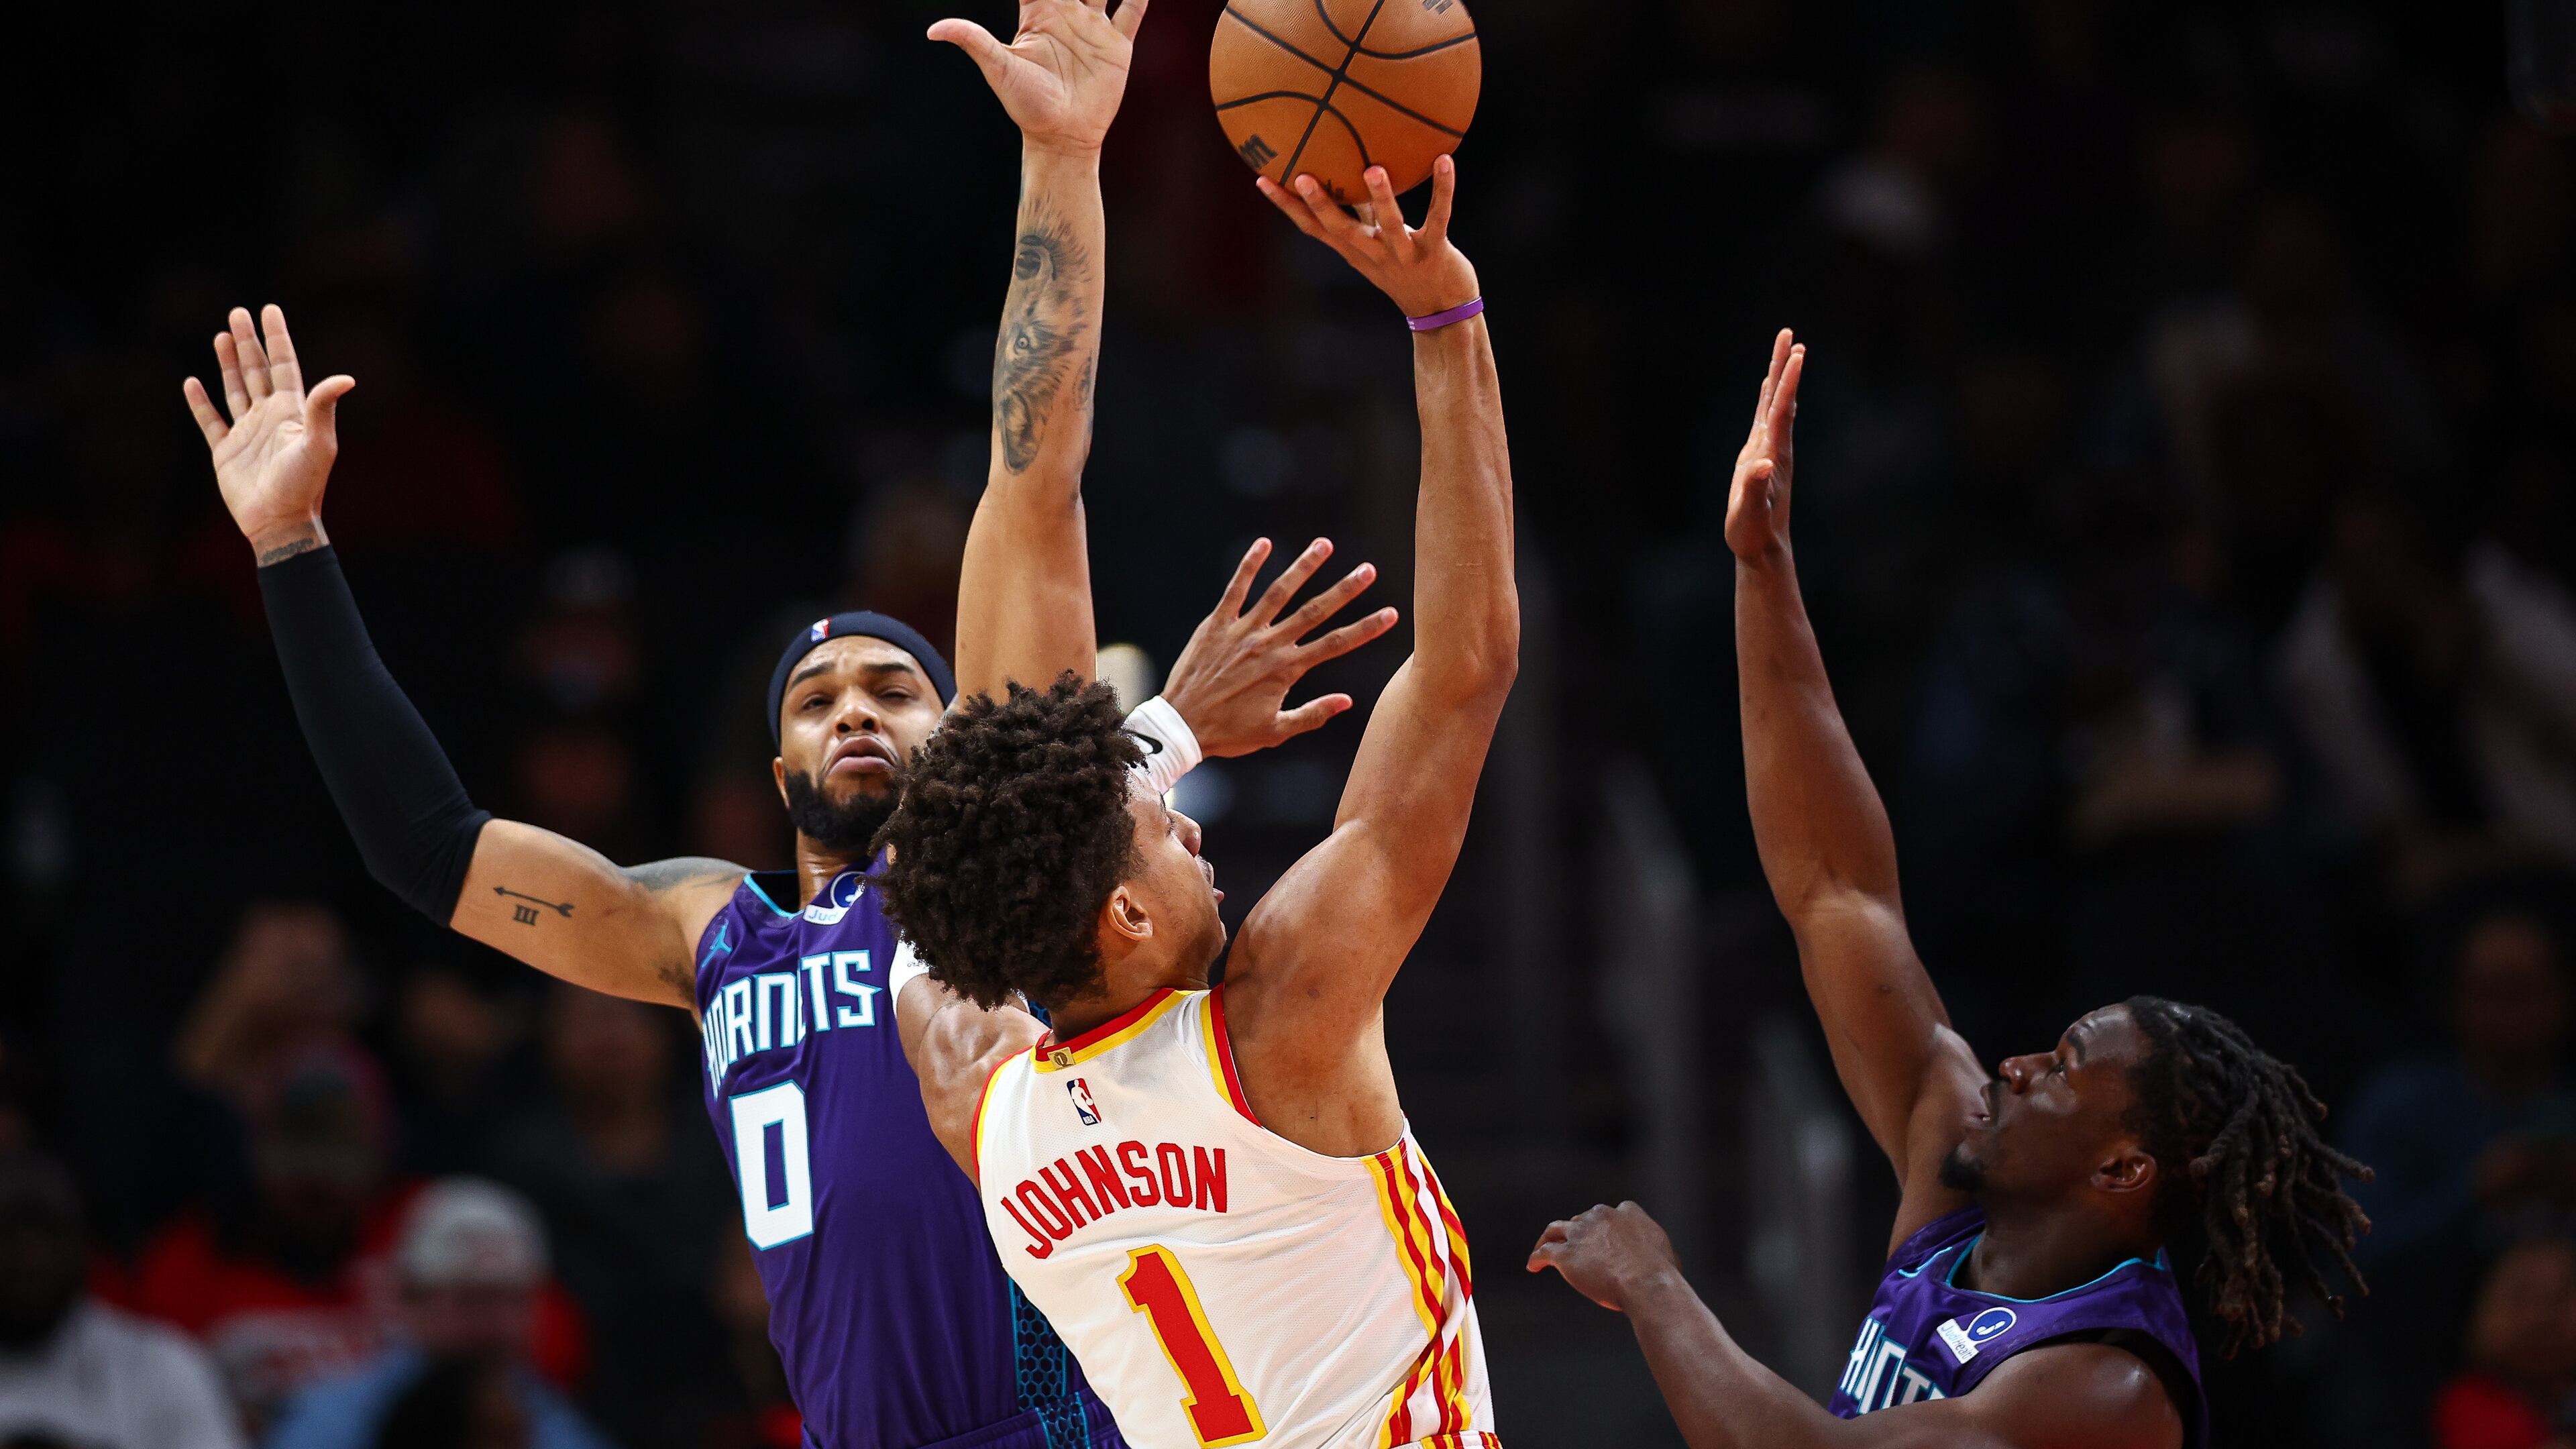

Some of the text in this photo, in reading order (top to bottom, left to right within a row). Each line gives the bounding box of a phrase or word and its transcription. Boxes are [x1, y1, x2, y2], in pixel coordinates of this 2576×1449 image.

[729, 1079, 814, 1251] 0
[1082, 1115, 1096, 1125] NBA
[1001, 1140, 1228, 1259] JOHNSON
[1116, 1244, 1268, 1448] 1
